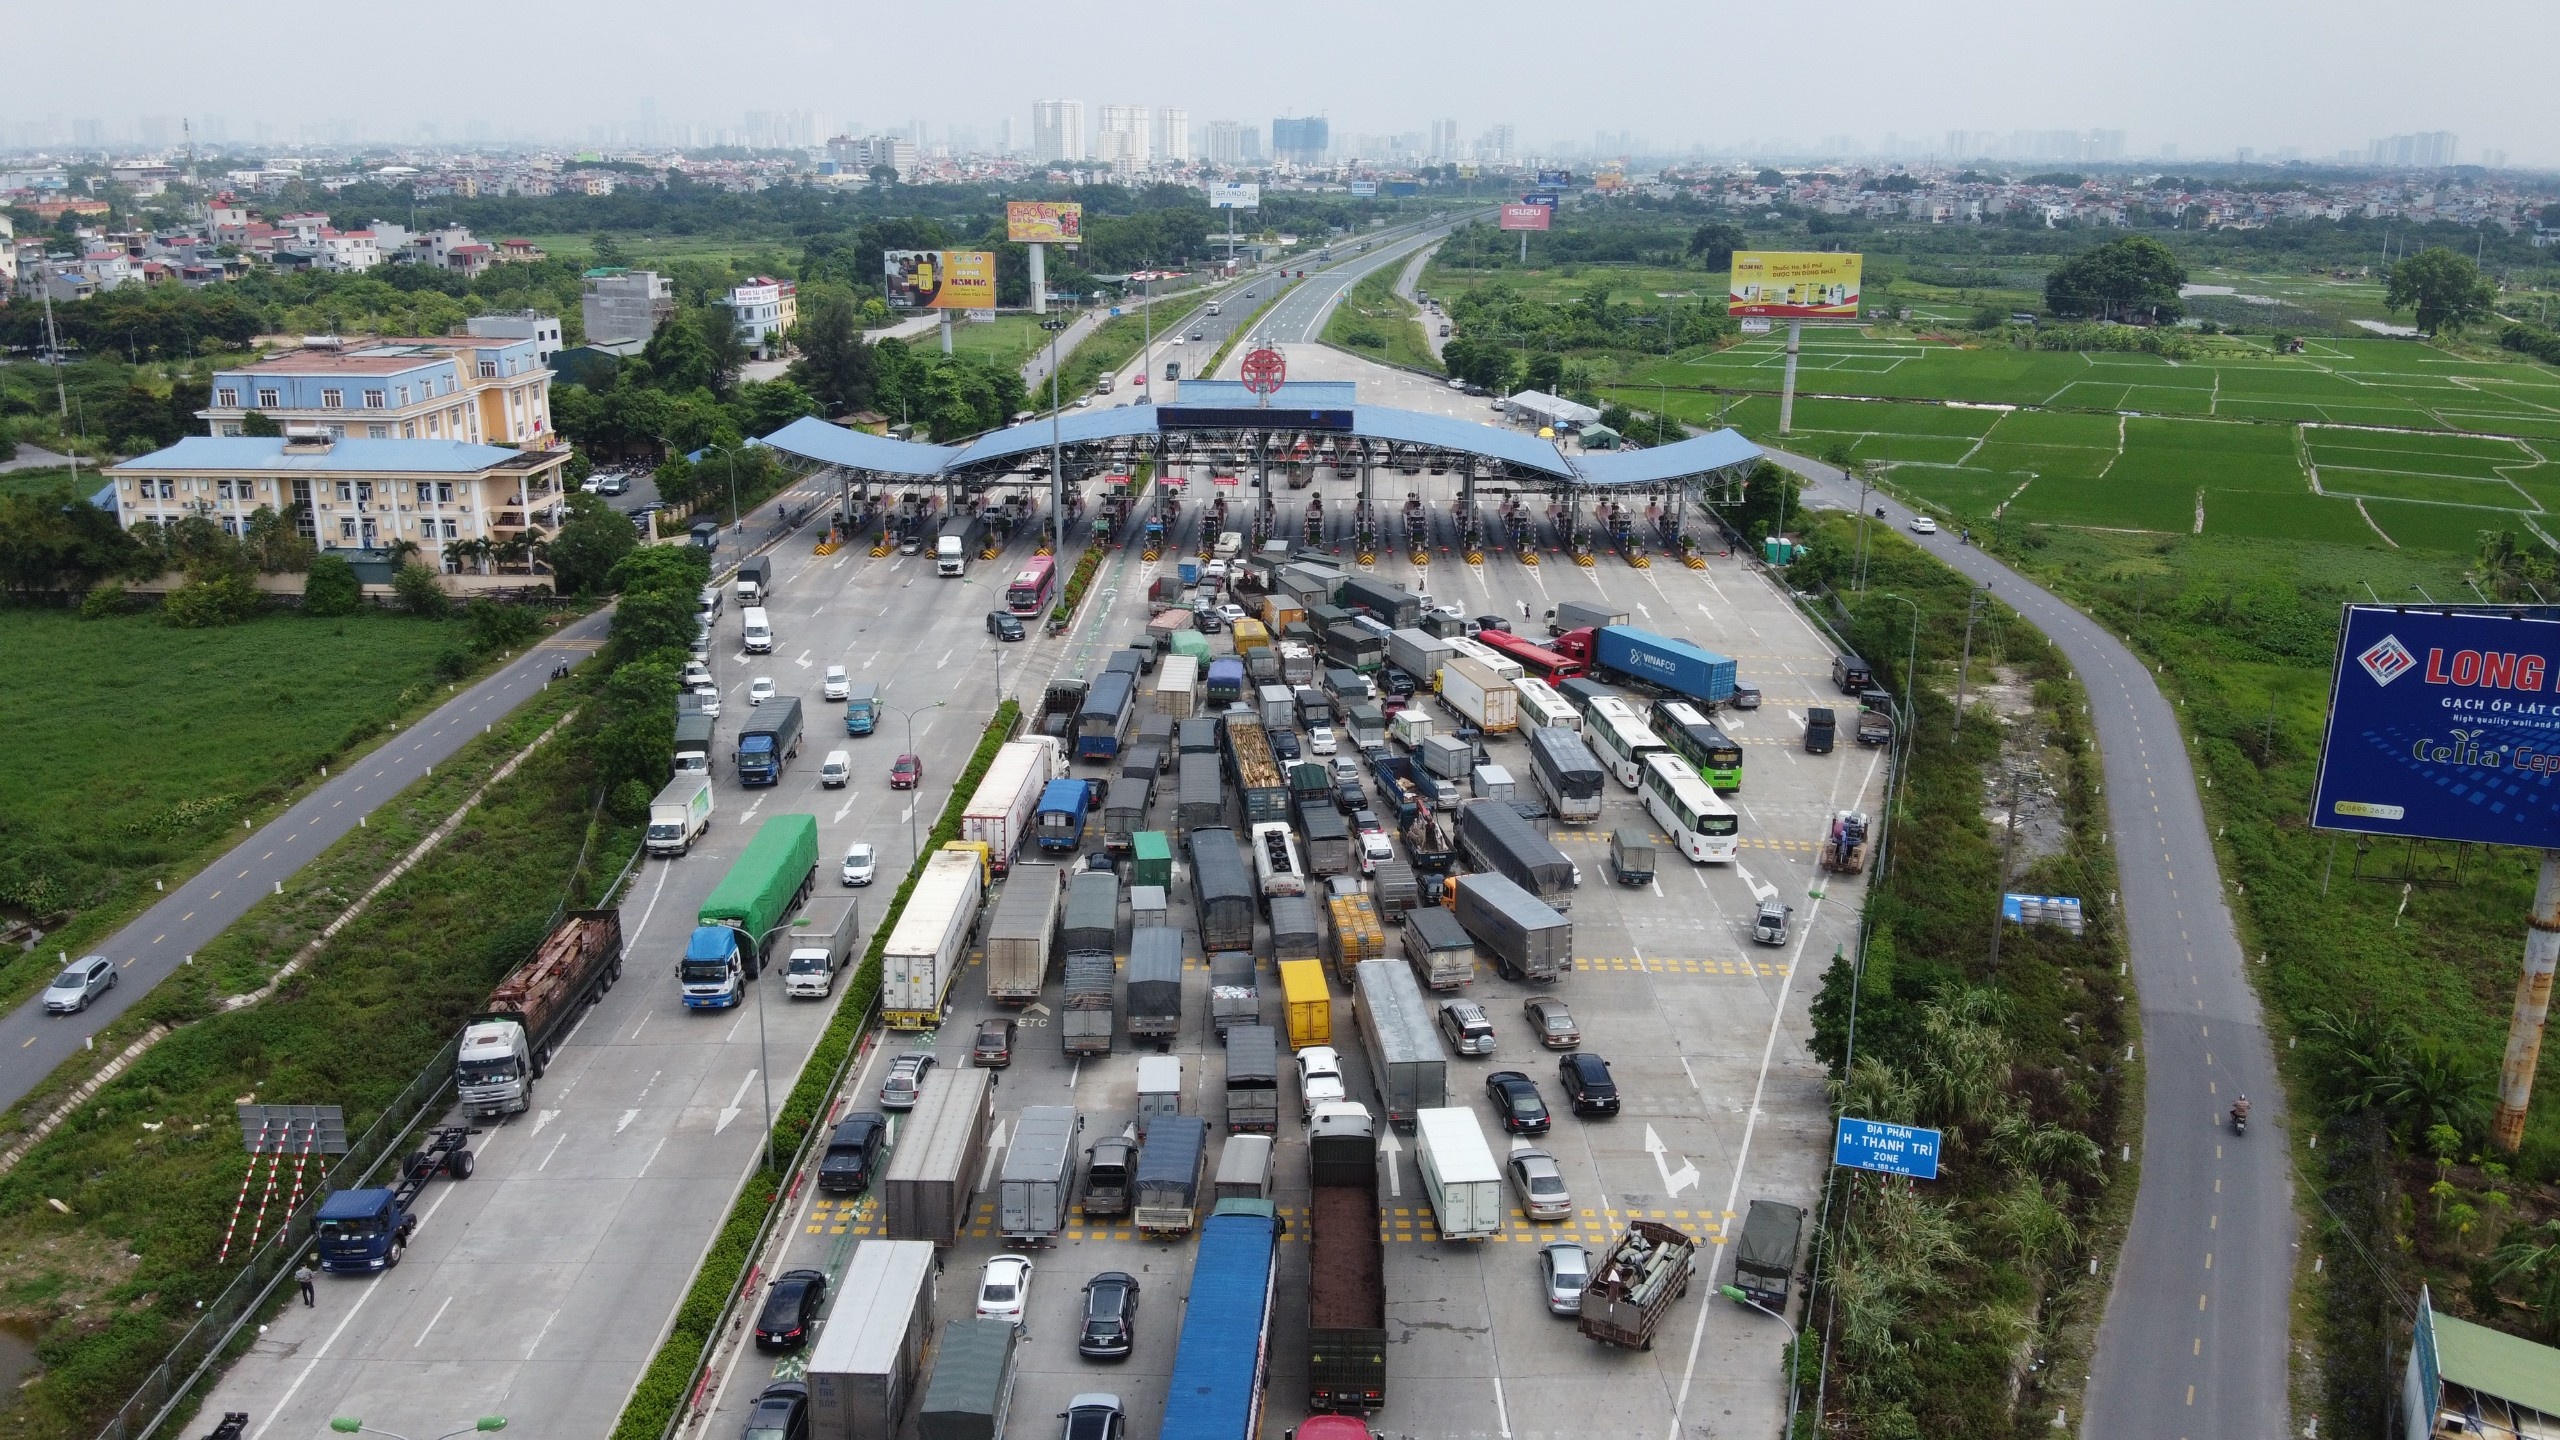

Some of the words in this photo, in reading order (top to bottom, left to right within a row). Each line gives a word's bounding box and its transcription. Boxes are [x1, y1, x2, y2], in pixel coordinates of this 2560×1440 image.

[1508, 208, 1541, 216] ISUZU
[951, 278, 972, 286] NAM
[1643, 653, 1676, 672] VINAFCO
[2425, 648, 2546, 692] LONG
[2441, 697, 2484, 711] GẠCH
[2491, 698, 2512, 712] ỐP
[2518, 702, 2546, 715] LÁT
[2453, 714, 2474, 724] High
[2477, 717, 2510, 727] quality
[2512, 719, 2532, 727] wall
[2535, 721, 2551, 729] and
[2413, 738, 2500, 768] Celia
[1017, 1018, 1048, 1028] ETC
[1867, 1124, 1883, 1136] ĐỊA
[1886, 1126, 1912, 1140] PHẬN
[1911, 1142, 1933, 1157] TRÌ
[1862, 1160, 1875, 1169] Km
[1873, 1151, 1899, 1164] ZONE
